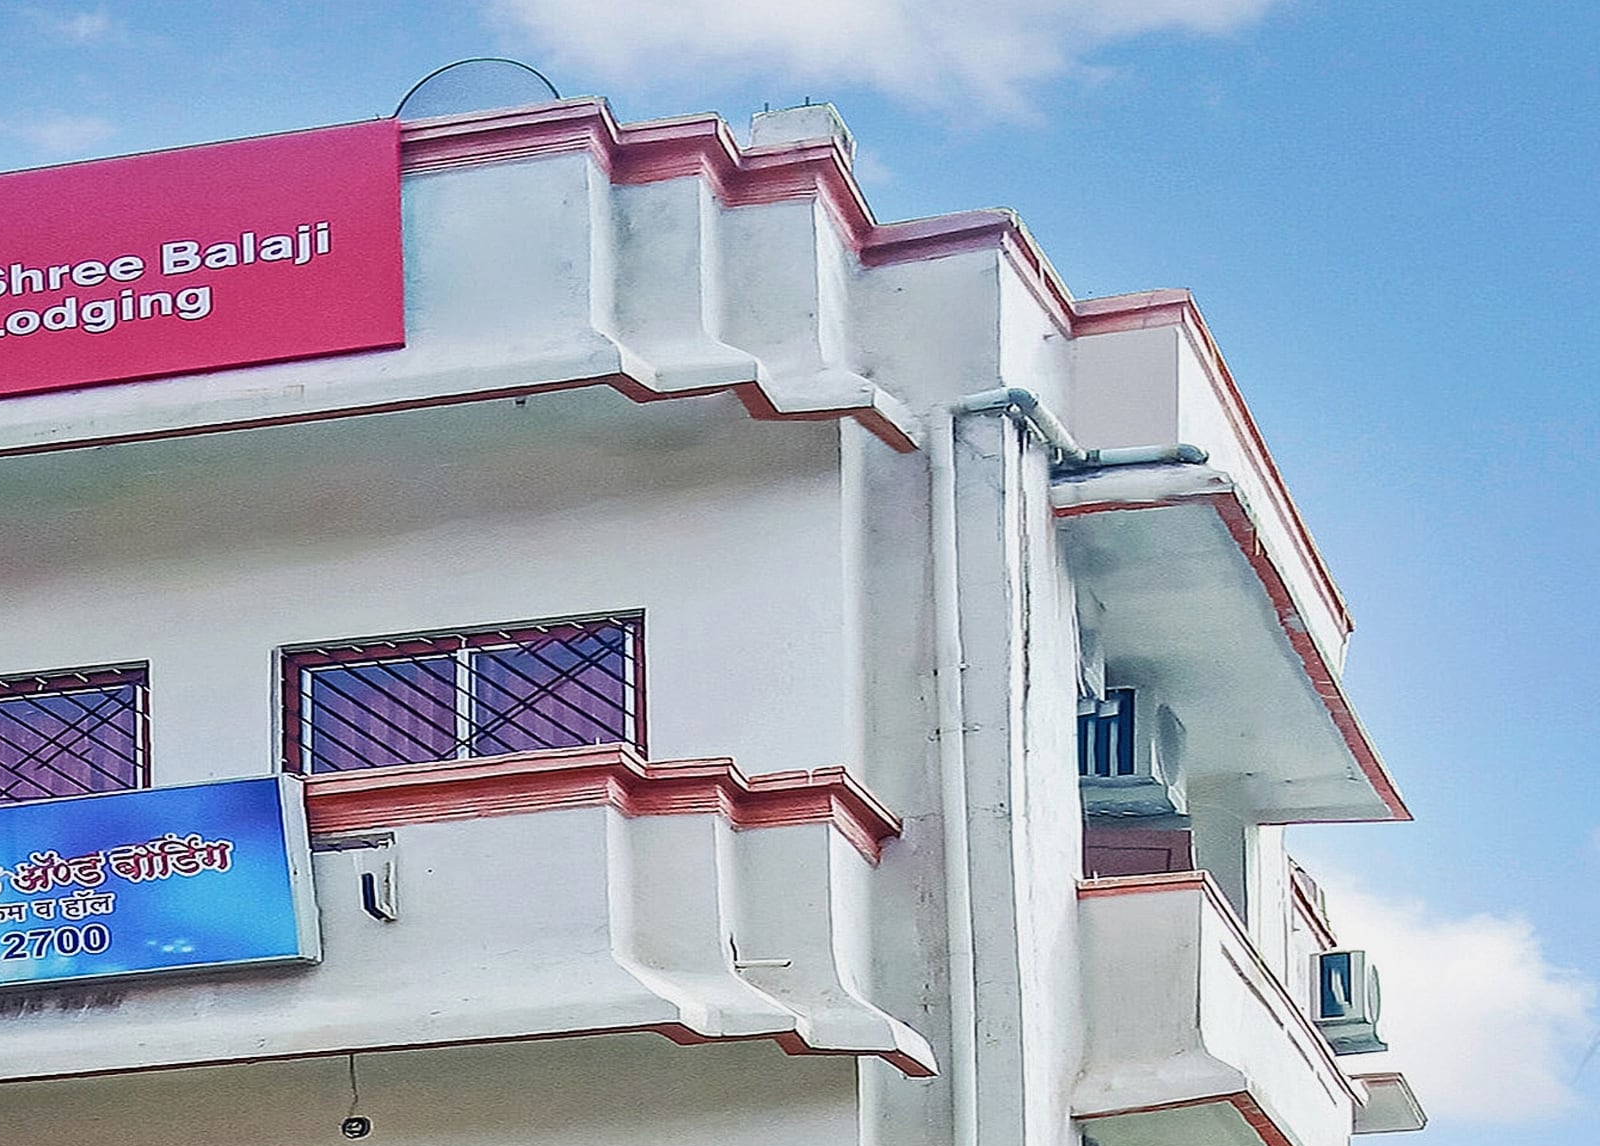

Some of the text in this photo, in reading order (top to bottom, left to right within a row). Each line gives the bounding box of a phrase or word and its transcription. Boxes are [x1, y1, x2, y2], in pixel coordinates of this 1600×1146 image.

[160, 221, 331, 276] Balaji
[33, 900, 55, 918] व
[61, 891, 115, 915] हॉल
